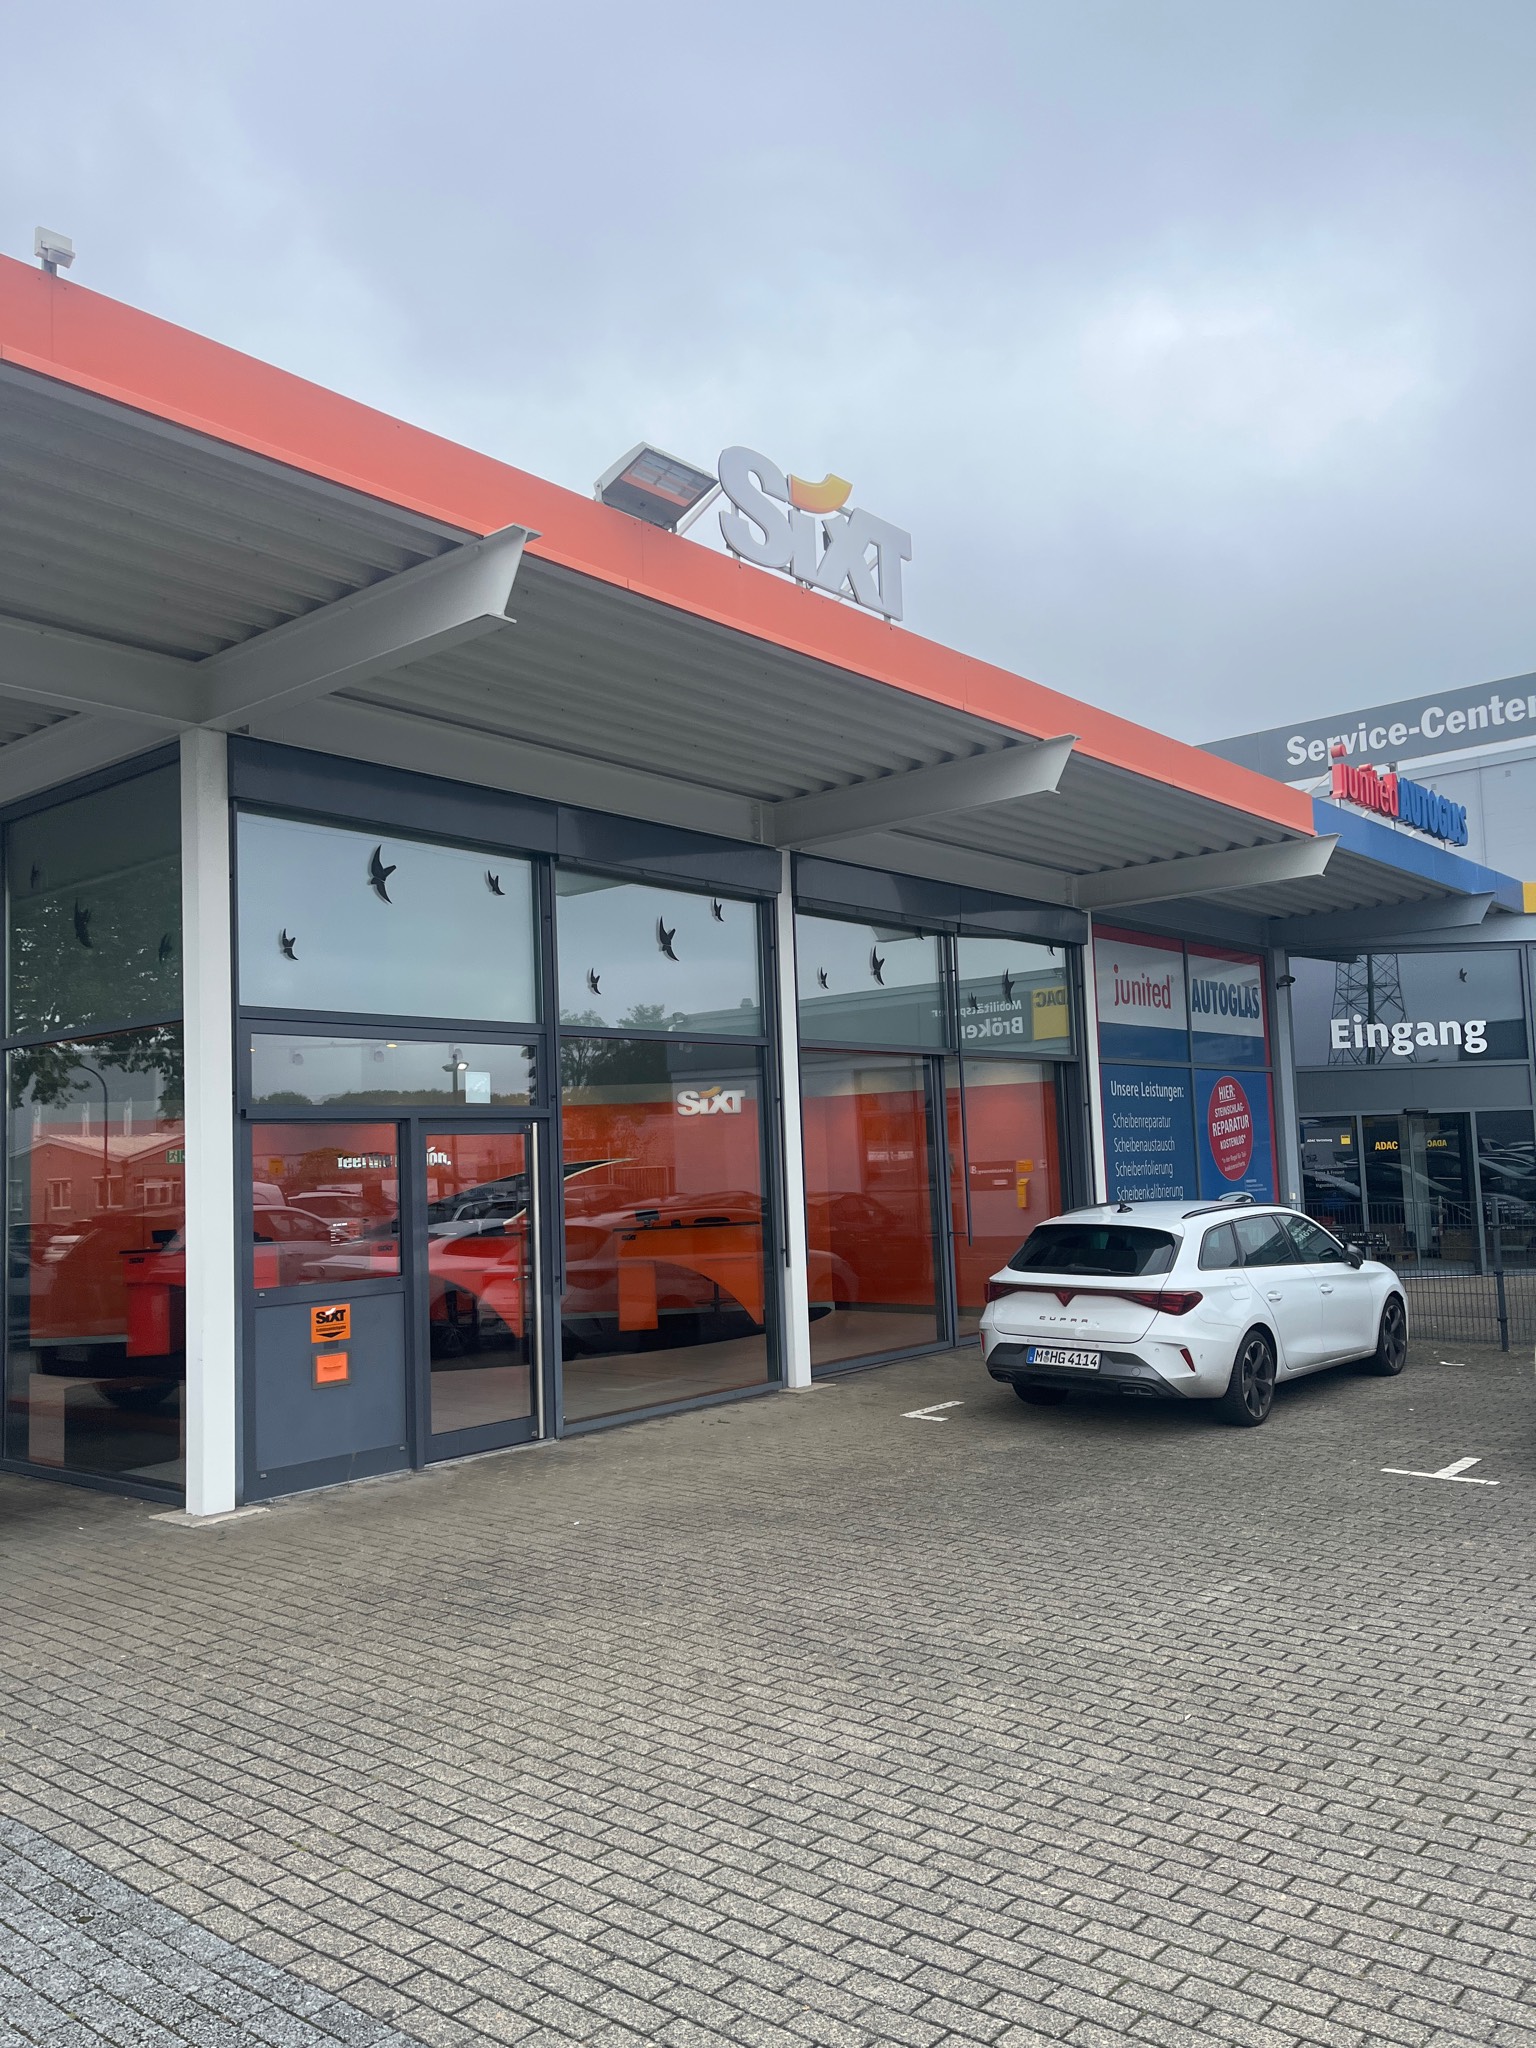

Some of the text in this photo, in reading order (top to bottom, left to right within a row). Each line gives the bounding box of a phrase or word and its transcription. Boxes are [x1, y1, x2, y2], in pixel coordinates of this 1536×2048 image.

[1398, 777, 1469, 847] AUTOGLAS
[1114, 963, 1260, 1020] junited AUTOGLAS
[1330, 1014, 1488, 1056] Eingang
[1110, 1080, 1185, 1102] Unsere Leistungen:
[1218, 1084, 1236, 1101] HIER:
[1112, 1112, 1171, 1132] Scheibenreparatur
[1212, 1114, 1250, 1137] REPARATUR
[1113, 1136, 1176, 1153] Scheibenaustausch
[1375, 1141, 1398, 1150] ADAC
[1115, 1160, 1174, 1178] Scheibenfolierung
[1116, 1183, 1184, 1201] Scheibenkalibrierung
[1039, 1315, 1089, 1324] CUPRA
[1067, 1352, 1098, 1368] 4114
